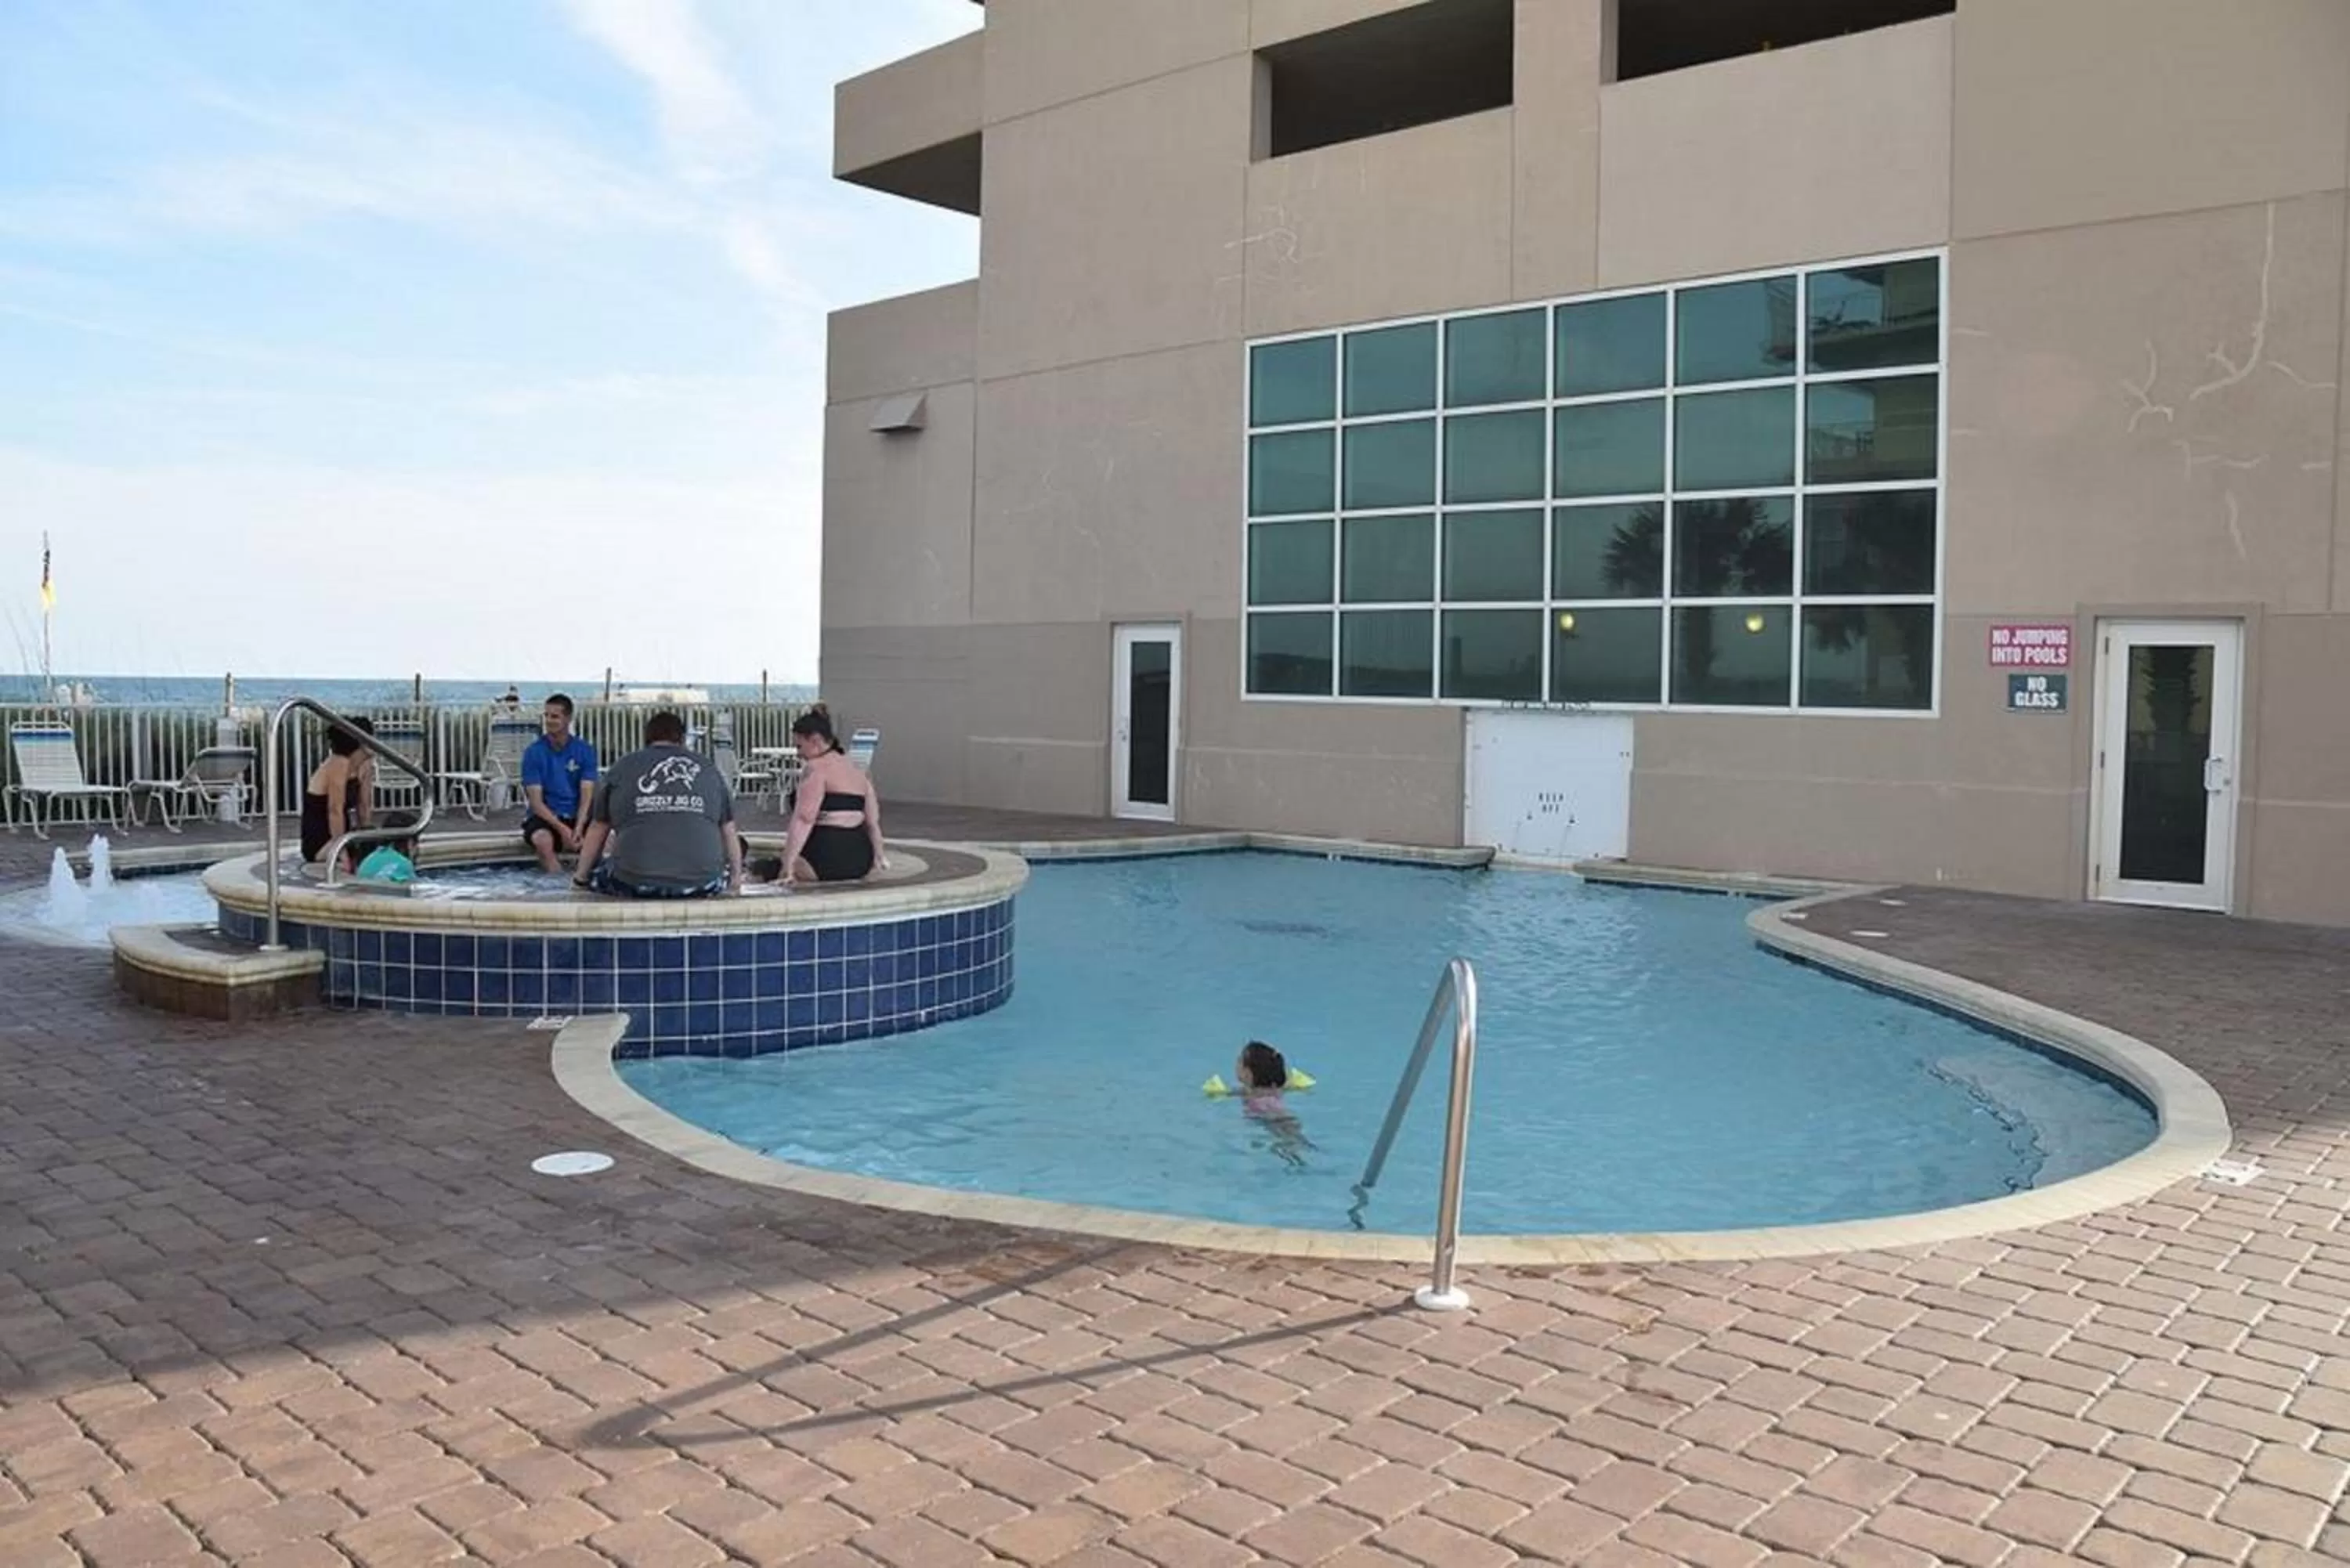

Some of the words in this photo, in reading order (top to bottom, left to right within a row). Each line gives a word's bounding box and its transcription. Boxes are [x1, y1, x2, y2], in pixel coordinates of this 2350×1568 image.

[1992, 629, 2010, 645] NO
[2012, 629, 2068, 645] JUMPING
[1992, 647, 2022, 663] INTO
[2024, 646, 2068, 664] POOLS
[2026, 676, 2047, 692] NO
[2014, 691, 2059, 708] GLASS
